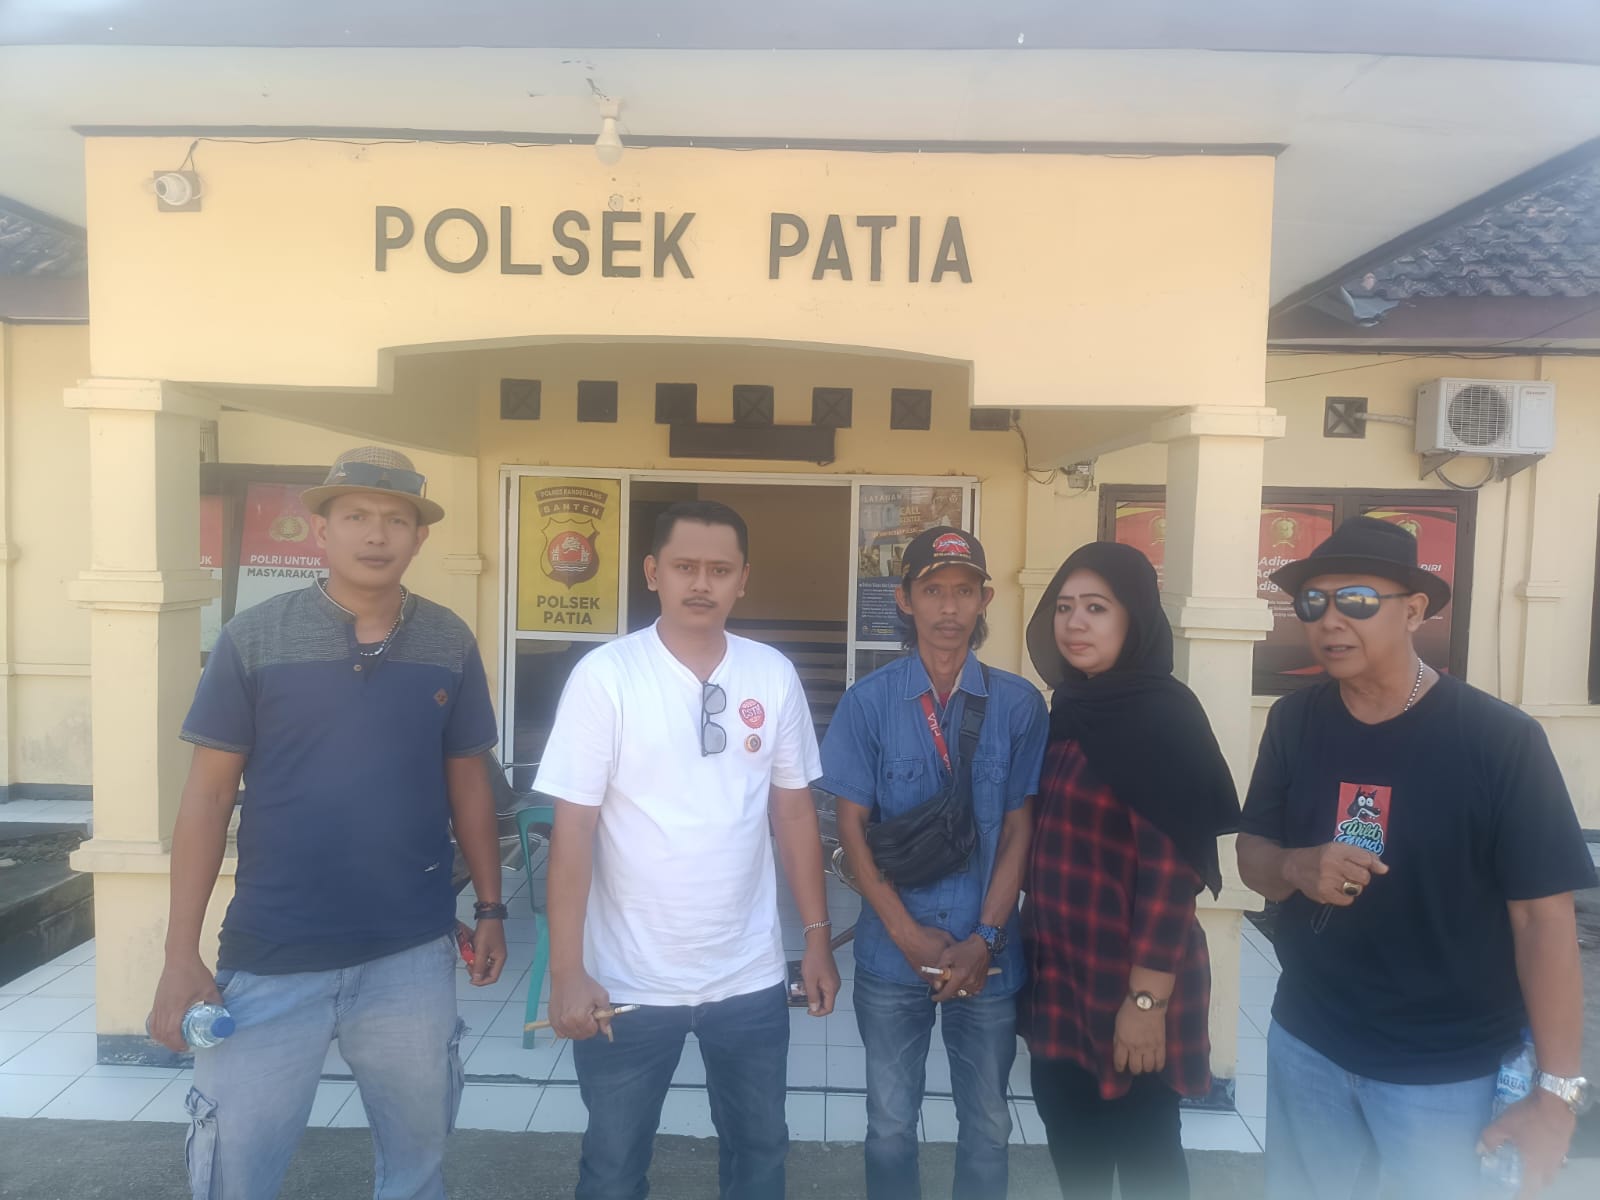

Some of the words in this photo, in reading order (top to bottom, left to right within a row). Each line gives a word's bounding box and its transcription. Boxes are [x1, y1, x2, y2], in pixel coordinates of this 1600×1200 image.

[375, 205, 696, 279] POLSEK
[768, 212, 972, 283] PATIA
[543, 503, 600, 515] BANTEN
[250, 554, 281, 565] POLRI
[285, 555, 321, 566] UNTUK
[247, 567, 323, 579] MASYARAKAT
[537, 595, 601, 610] POLSEK
[543, 611, 593, 625] PATIA
